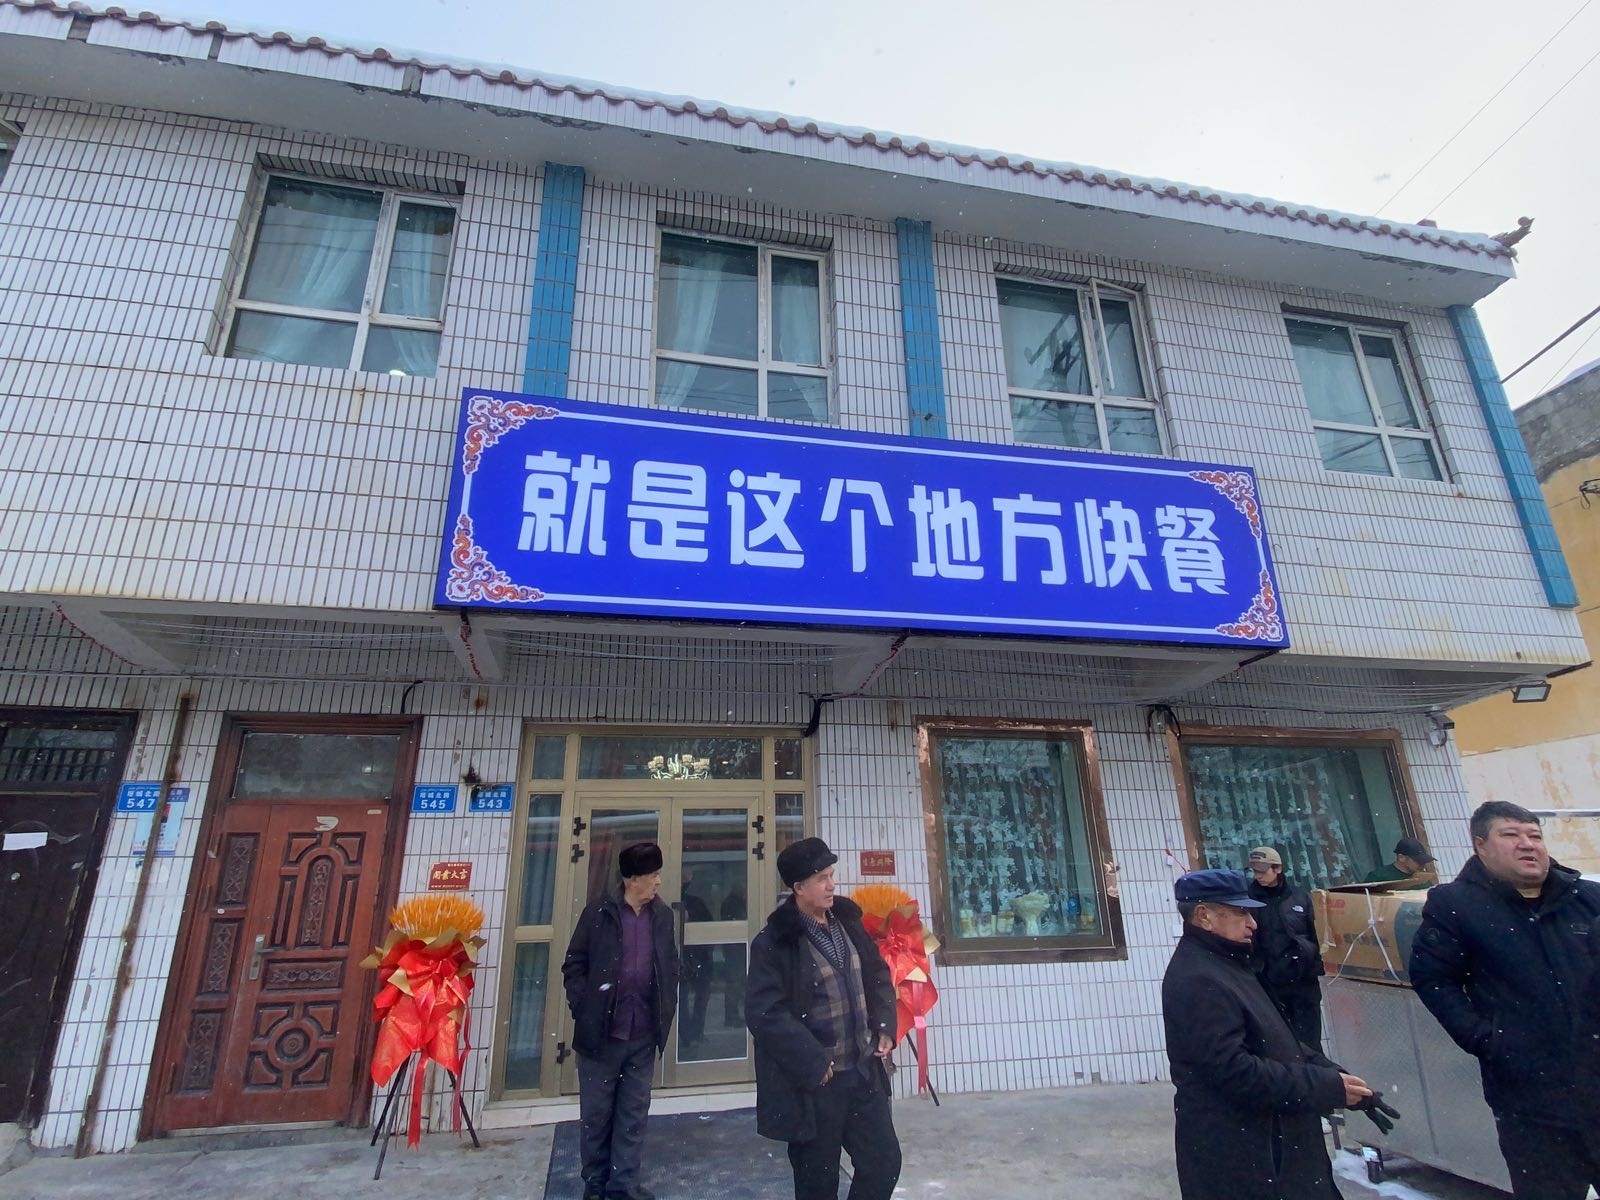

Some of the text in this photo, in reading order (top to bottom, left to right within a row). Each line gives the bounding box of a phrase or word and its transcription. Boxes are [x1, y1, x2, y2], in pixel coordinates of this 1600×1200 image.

[517, 450, 1229, 595] 就是这个地方快餐
[126, 798, 155, 809] 547
[420, 799, 446, 809] 545
[478, 798, 503, 809] 543
